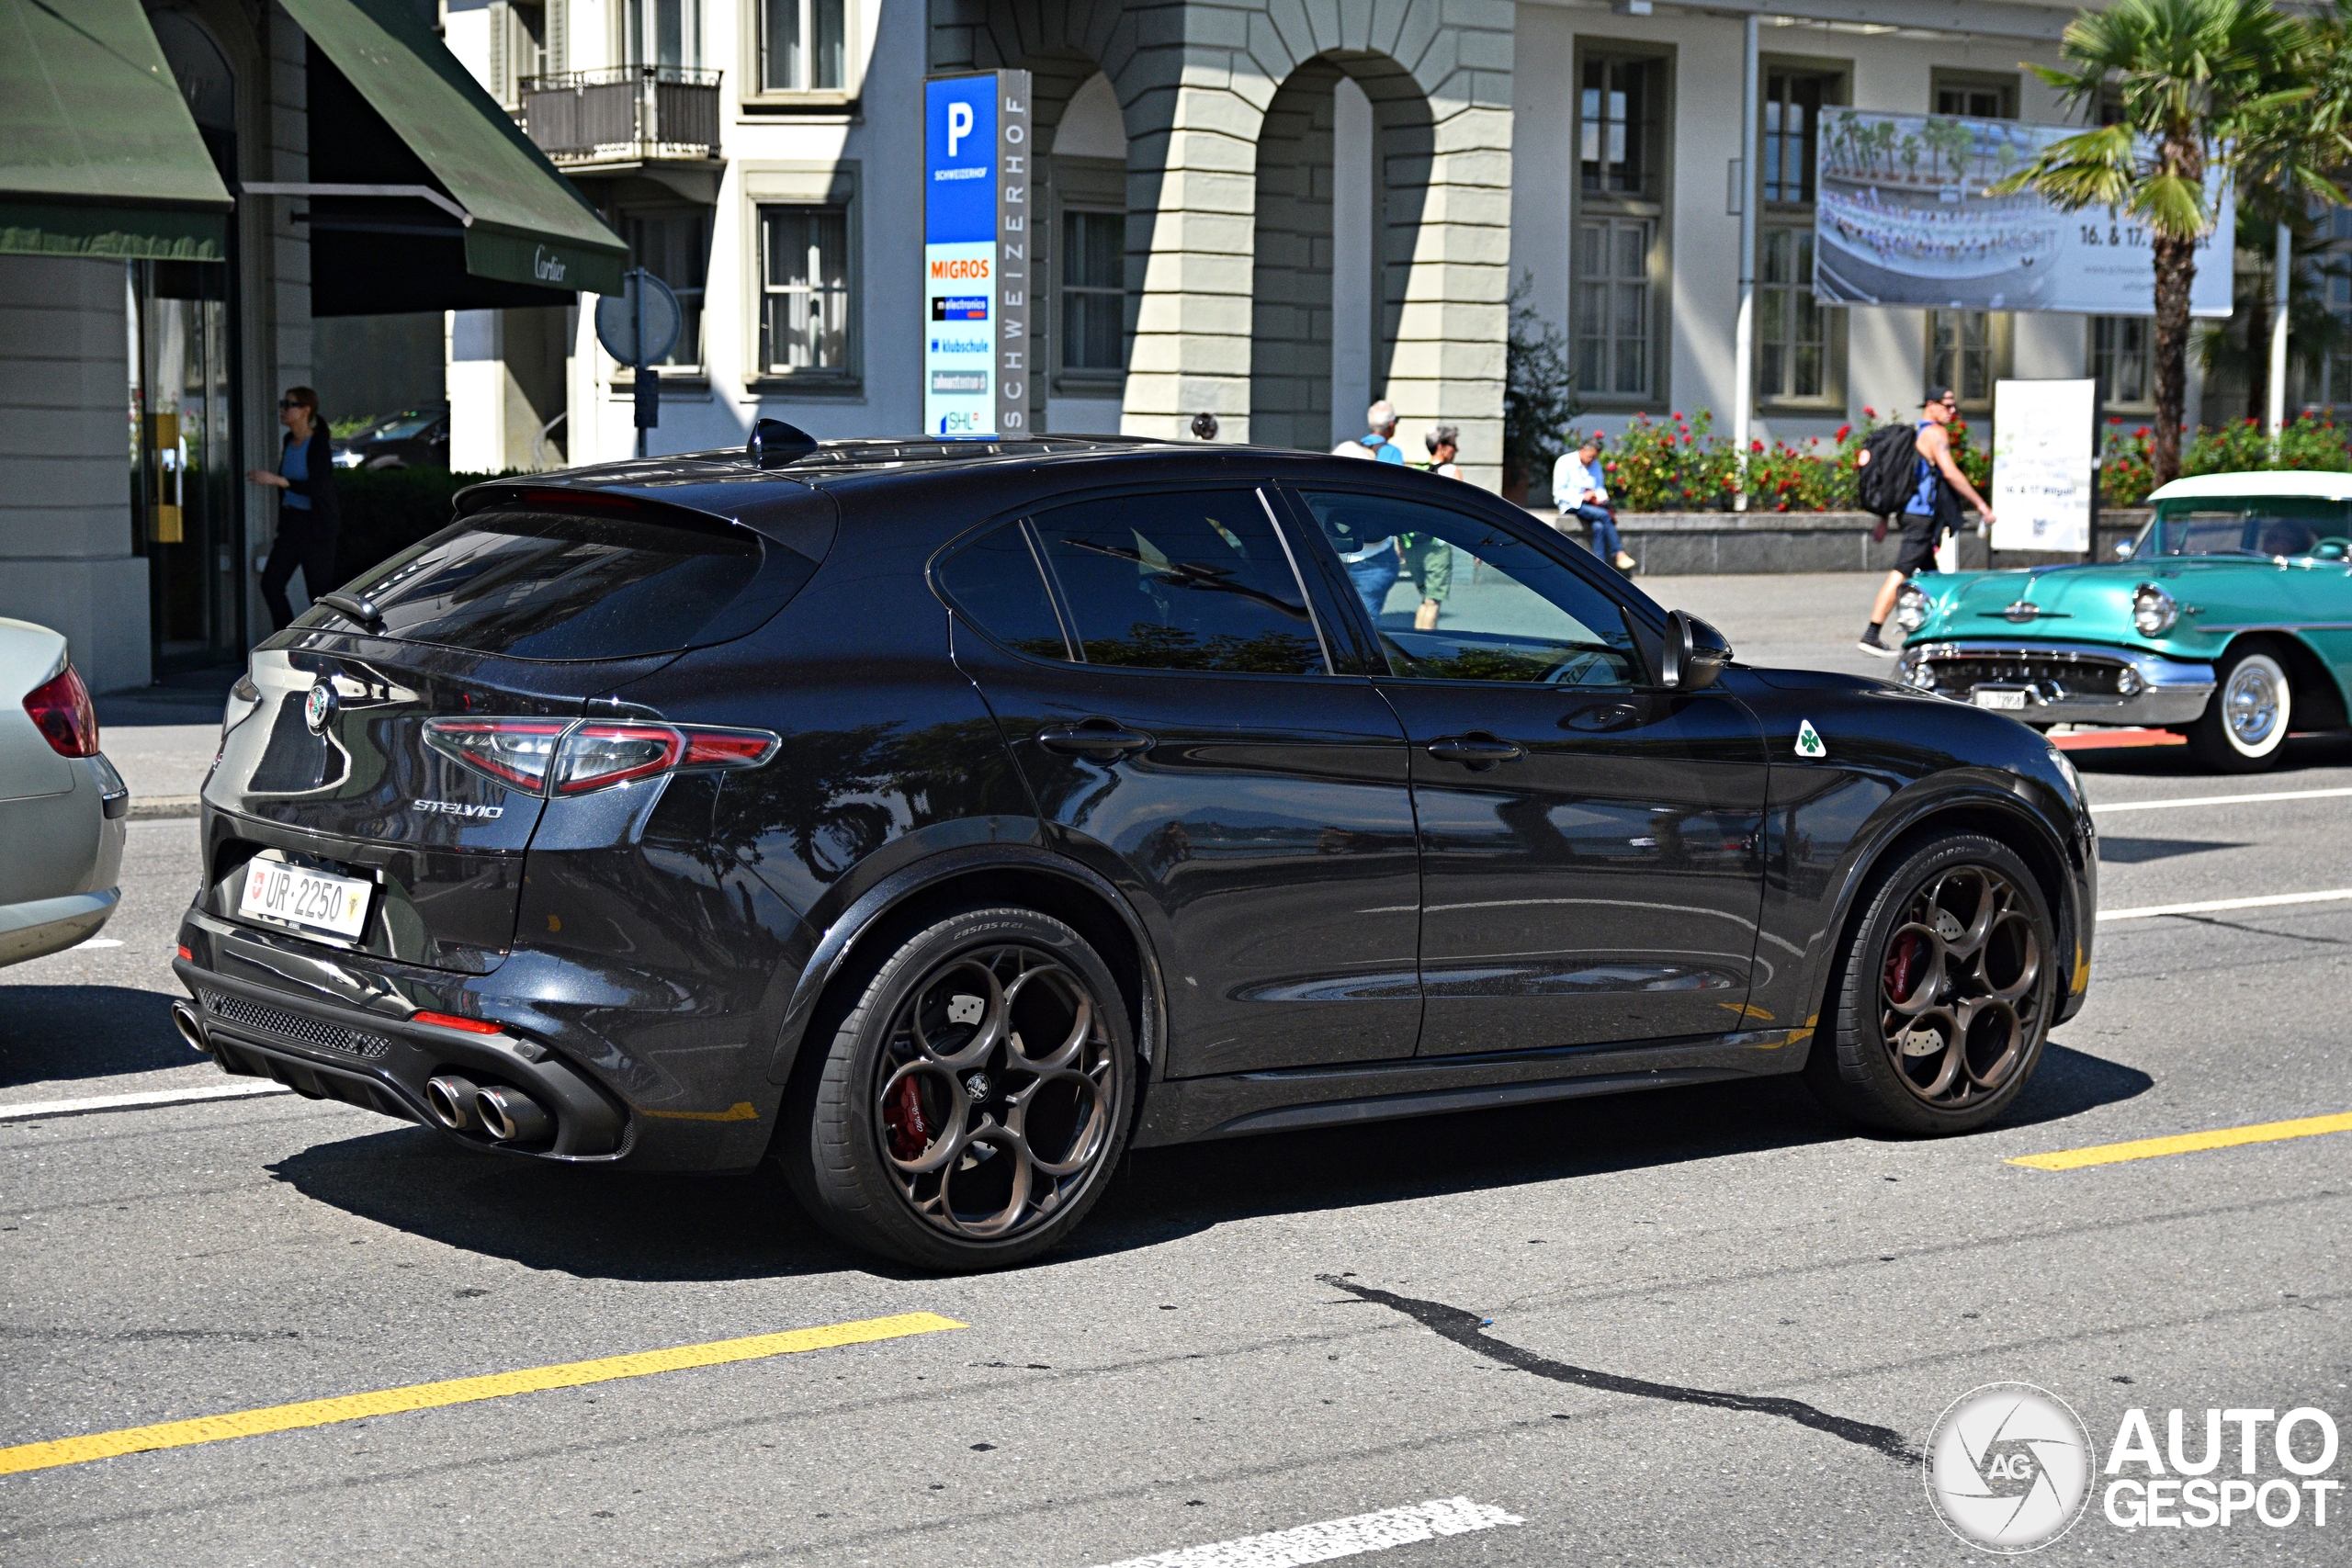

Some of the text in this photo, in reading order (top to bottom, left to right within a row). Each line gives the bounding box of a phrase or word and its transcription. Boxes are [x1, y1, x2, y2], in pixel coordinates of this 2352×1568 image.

[947, 102, 974, 157] P
[535, 243, 566, 282] Cartier
[931, 259, 989, 279] MIGROS
[1005, 96, 1025, 428] SCHWEIZERHOF
[942, 338, 989, 354] klubschule
[413, 799, 503, 818] STELVIO
